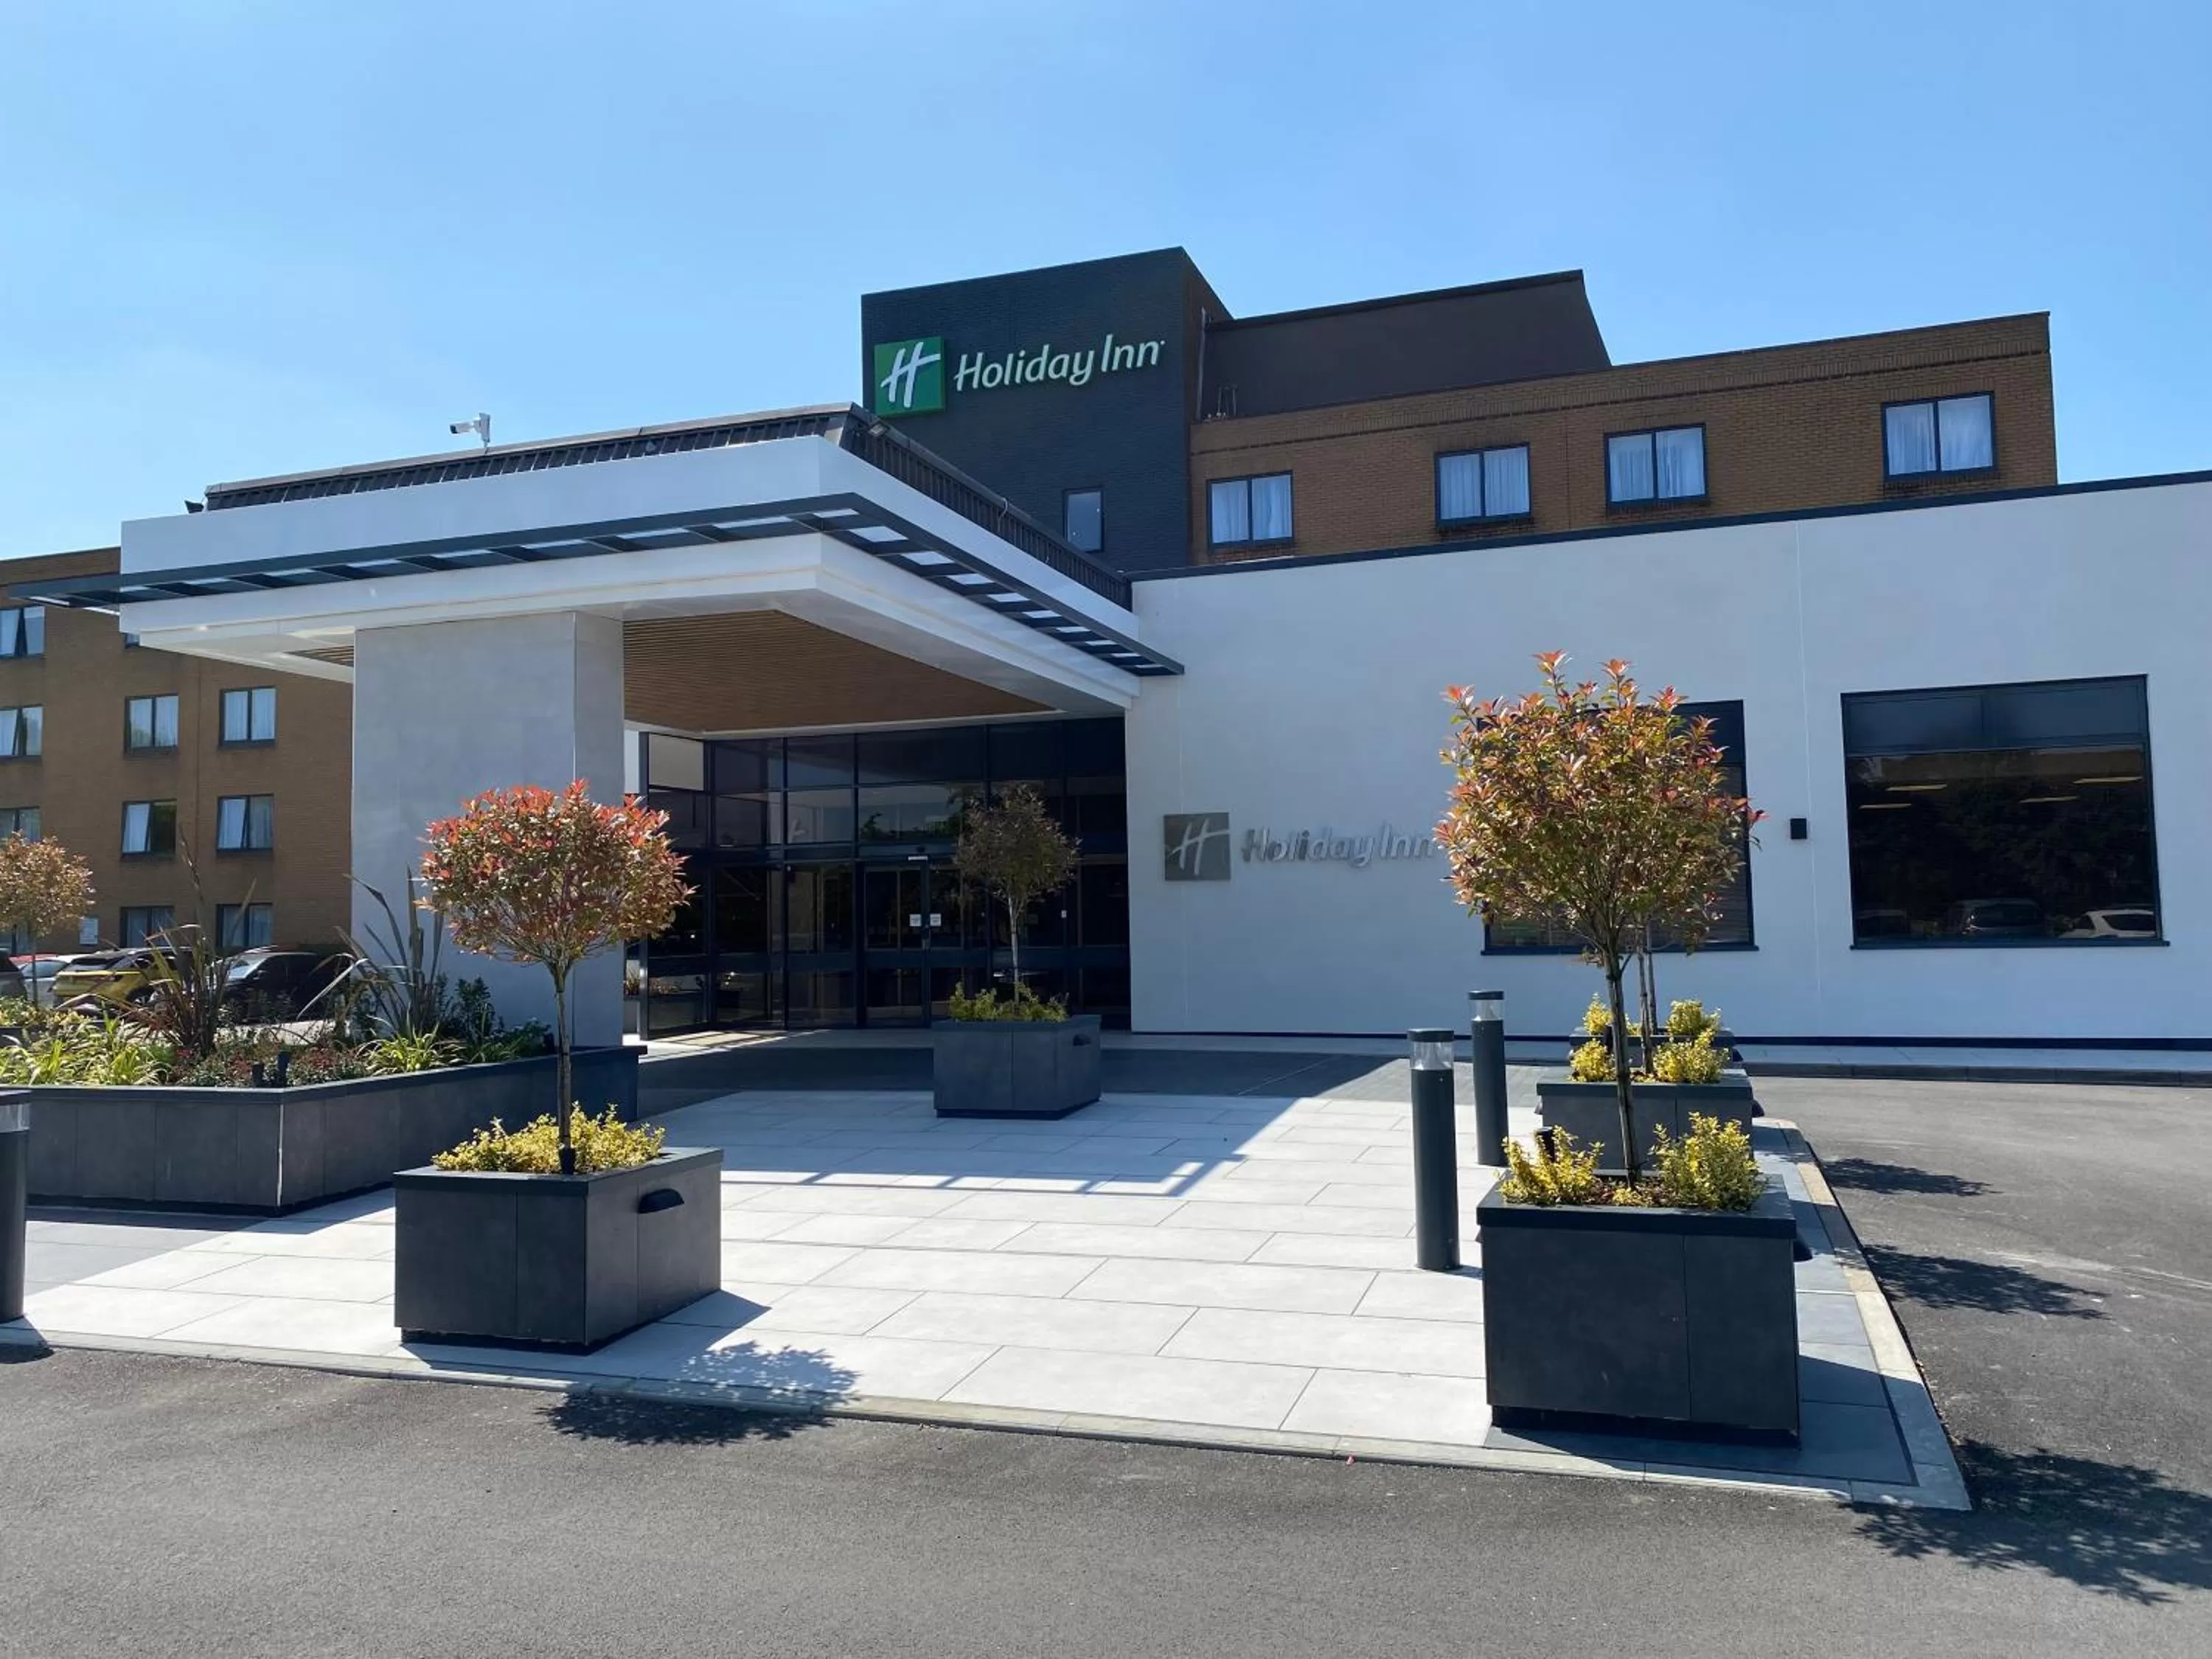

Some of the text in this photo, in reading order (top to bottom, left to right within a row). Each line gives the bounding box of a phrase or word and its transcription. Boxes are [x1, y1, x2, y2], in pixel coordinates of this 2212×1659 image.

[880, 341, 942, 408] H
[953, 333, 1159, 392] Holiday Inn
[1241, 820, 1433, 868] Holiday Inn
